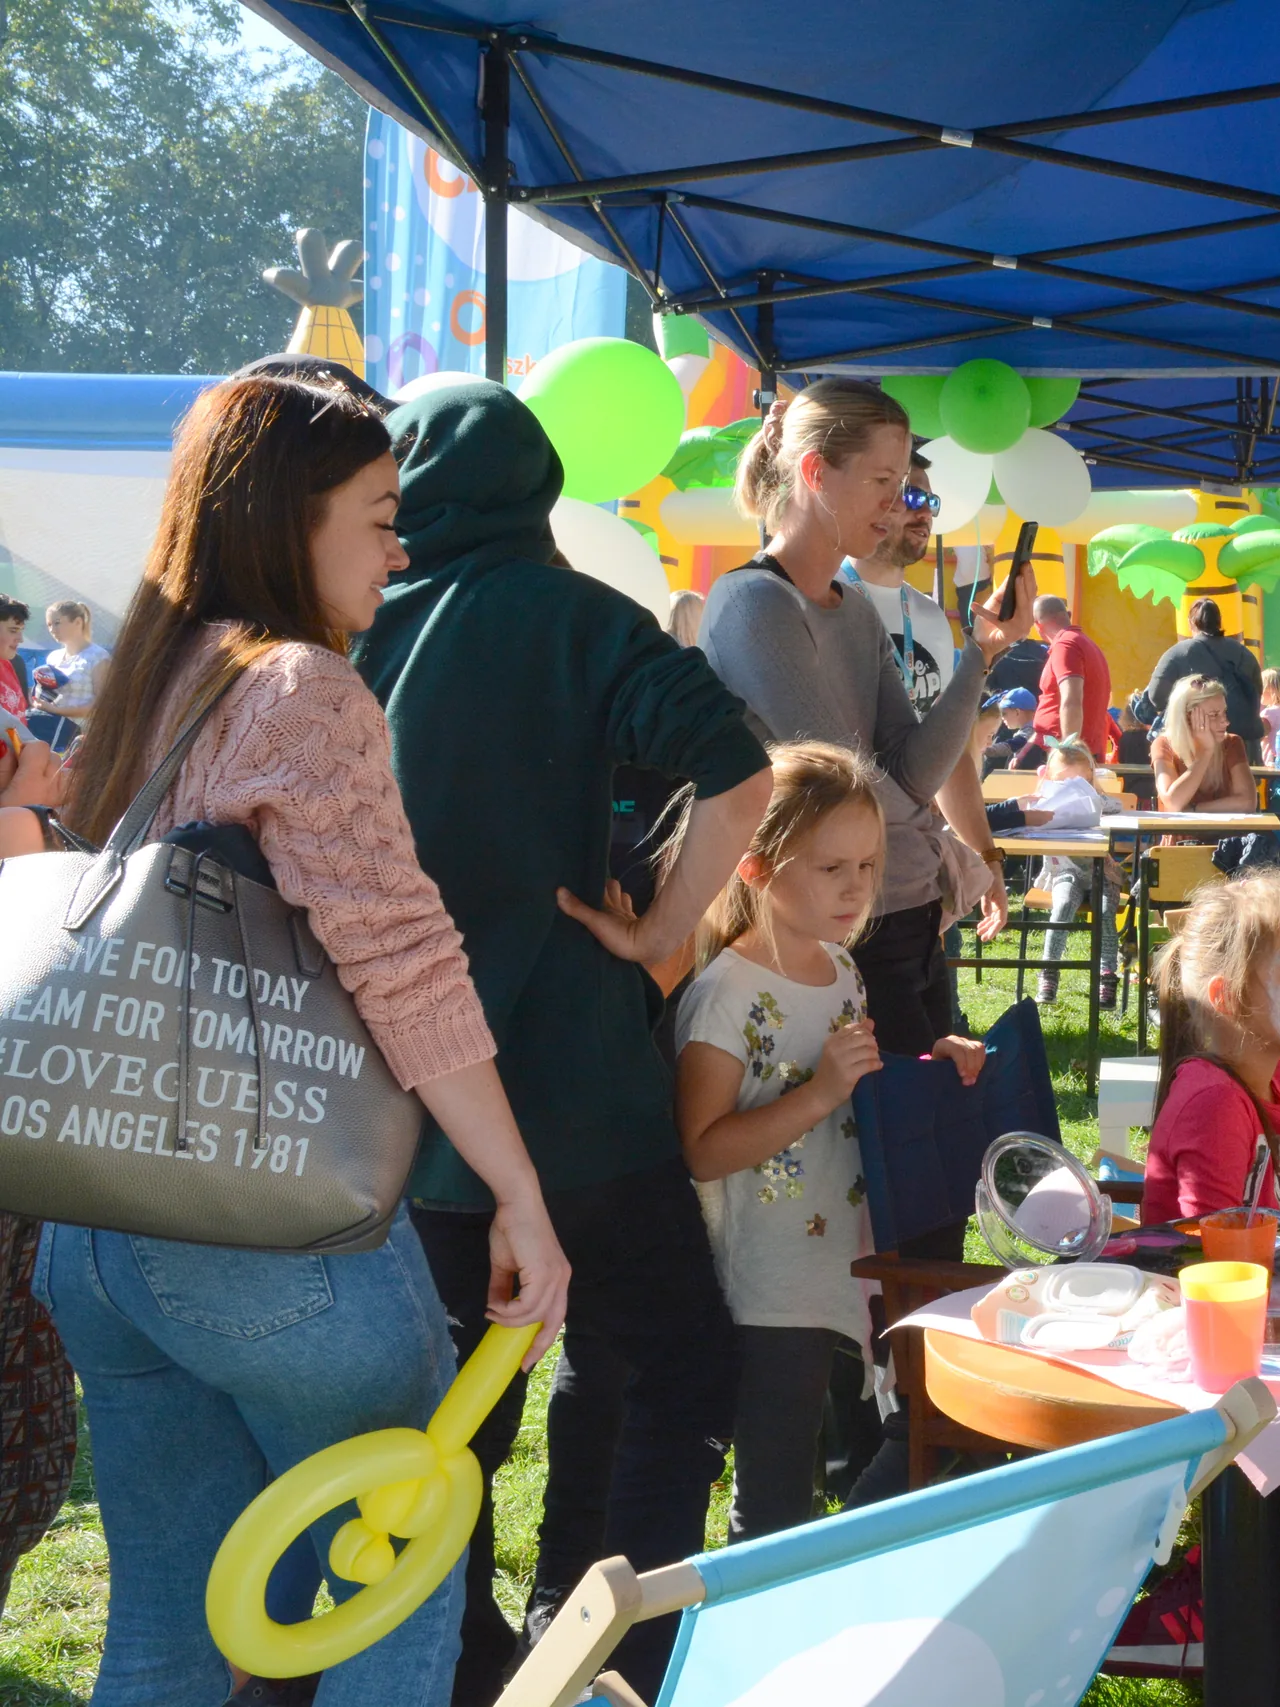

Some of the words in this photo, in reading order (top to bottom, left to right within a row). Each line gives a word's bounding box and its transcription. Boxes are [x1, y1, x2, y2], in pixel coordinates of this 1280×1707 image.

[507, 354, 537, 376] szk
[129, 941, 200, 990] FOR
[212, 957, 310, 1013] TODAY
[0, 985, 87, 1029] EAM
[92, 993, 165, 1042] FOR
[0, 1095, 51, 1139] OS
[57, 1104, 221, 1162] ANGELES
[234, 1128, 310, 1177] 1981
